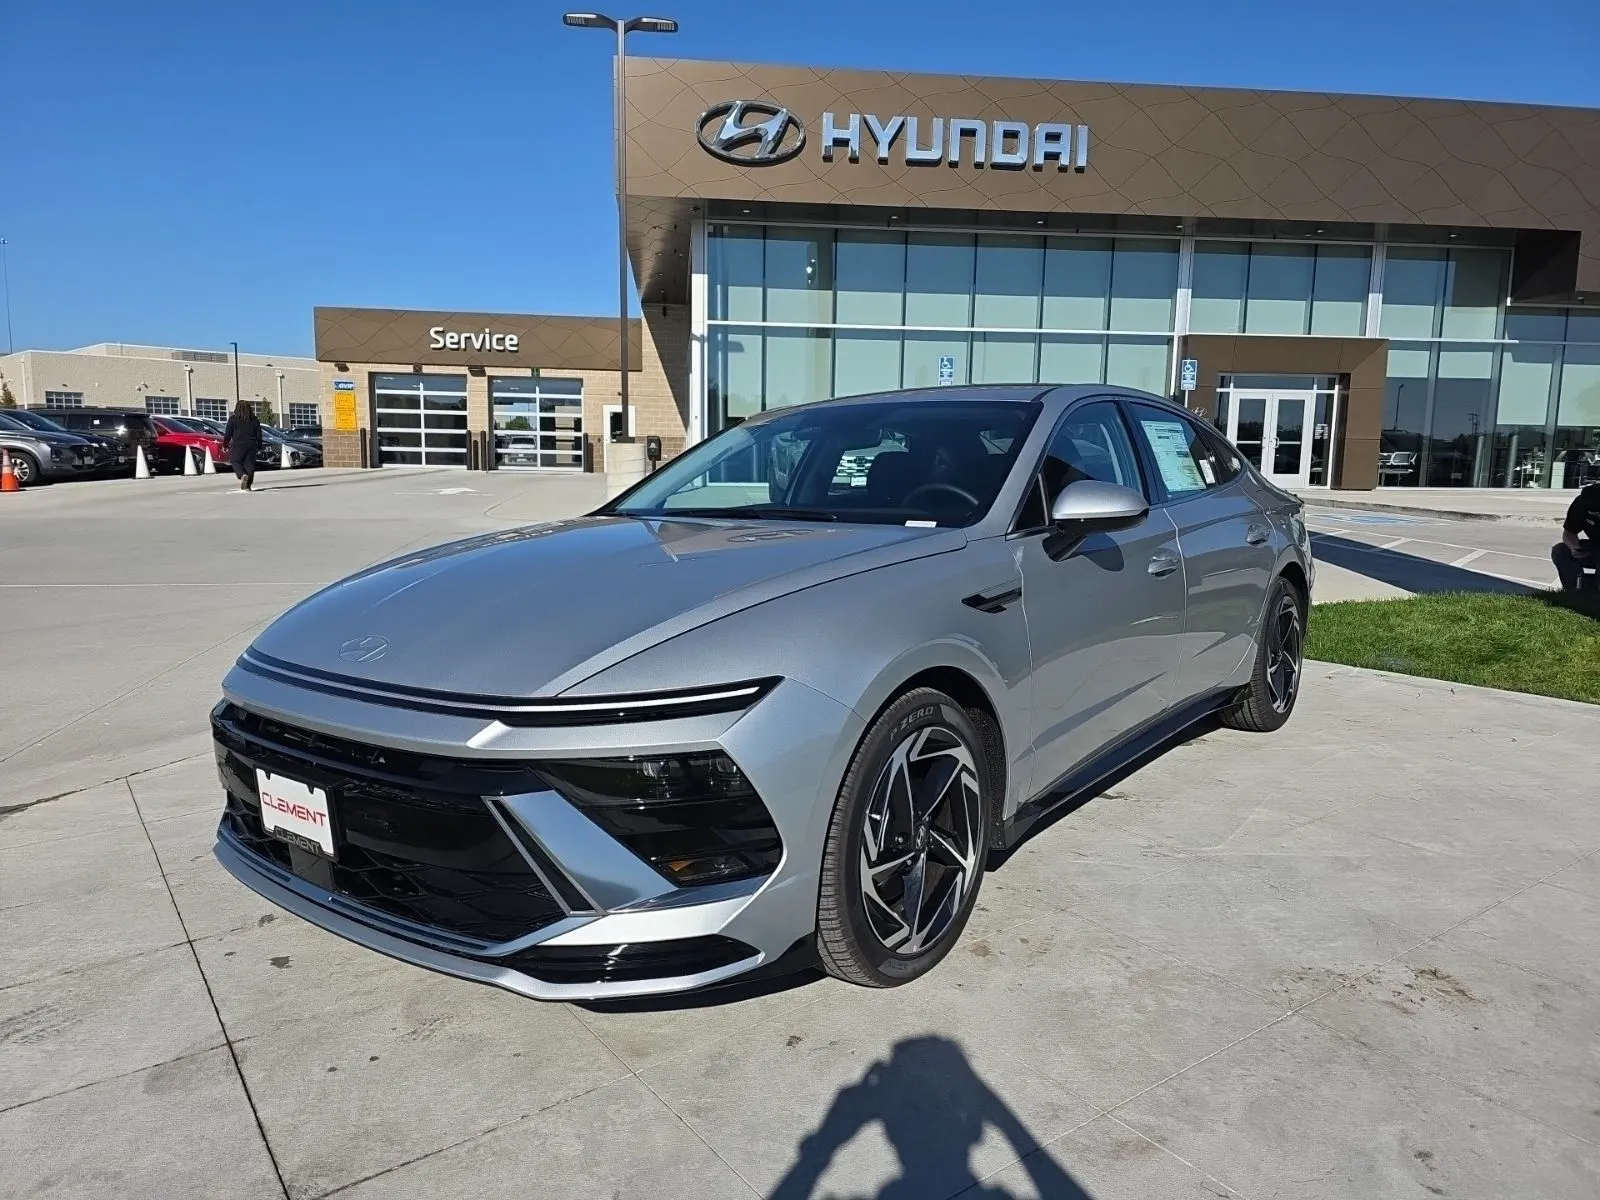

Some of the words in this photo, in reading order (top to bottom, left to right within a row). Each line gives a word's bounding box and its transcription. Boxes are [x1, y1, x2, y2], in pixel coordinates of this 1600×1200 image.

[821, 112, 1088, 172] HYUNDAI
[429, 326, 519, 352] Service
[890, 727, 898, 743] P
[900, 706, 934, 730] ZERO
[262, 792, 326, 826] CLEMENT
[275, 827, 320, 854] CLEMENT
